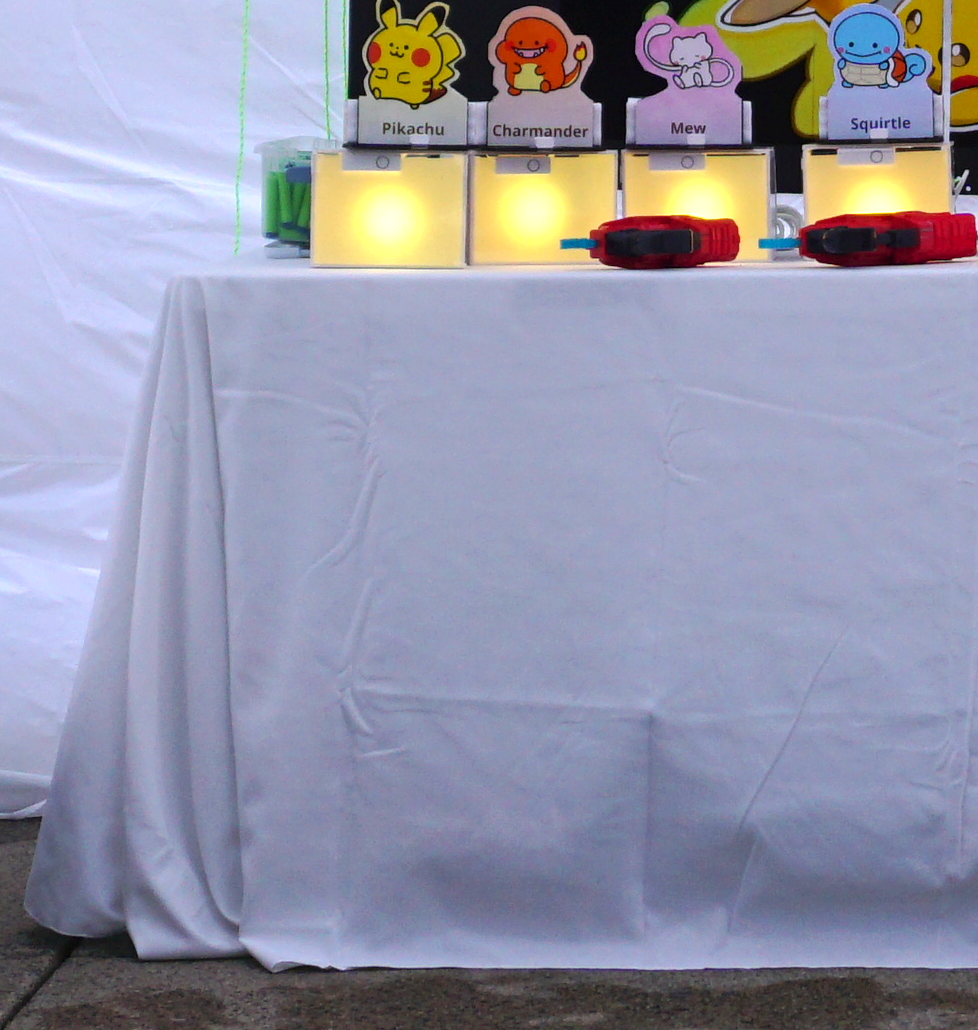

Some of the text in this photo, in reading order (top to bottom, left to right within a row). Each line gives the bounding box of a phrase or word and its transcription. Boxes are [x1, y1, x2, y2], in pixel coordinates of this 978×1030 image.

[381, 122, 445, 136] Pikachu
[492, 123, 589, 138] Charmander
[670, 121, 707, 135] Mew
[850, 117, 911, 132] Squirtle
